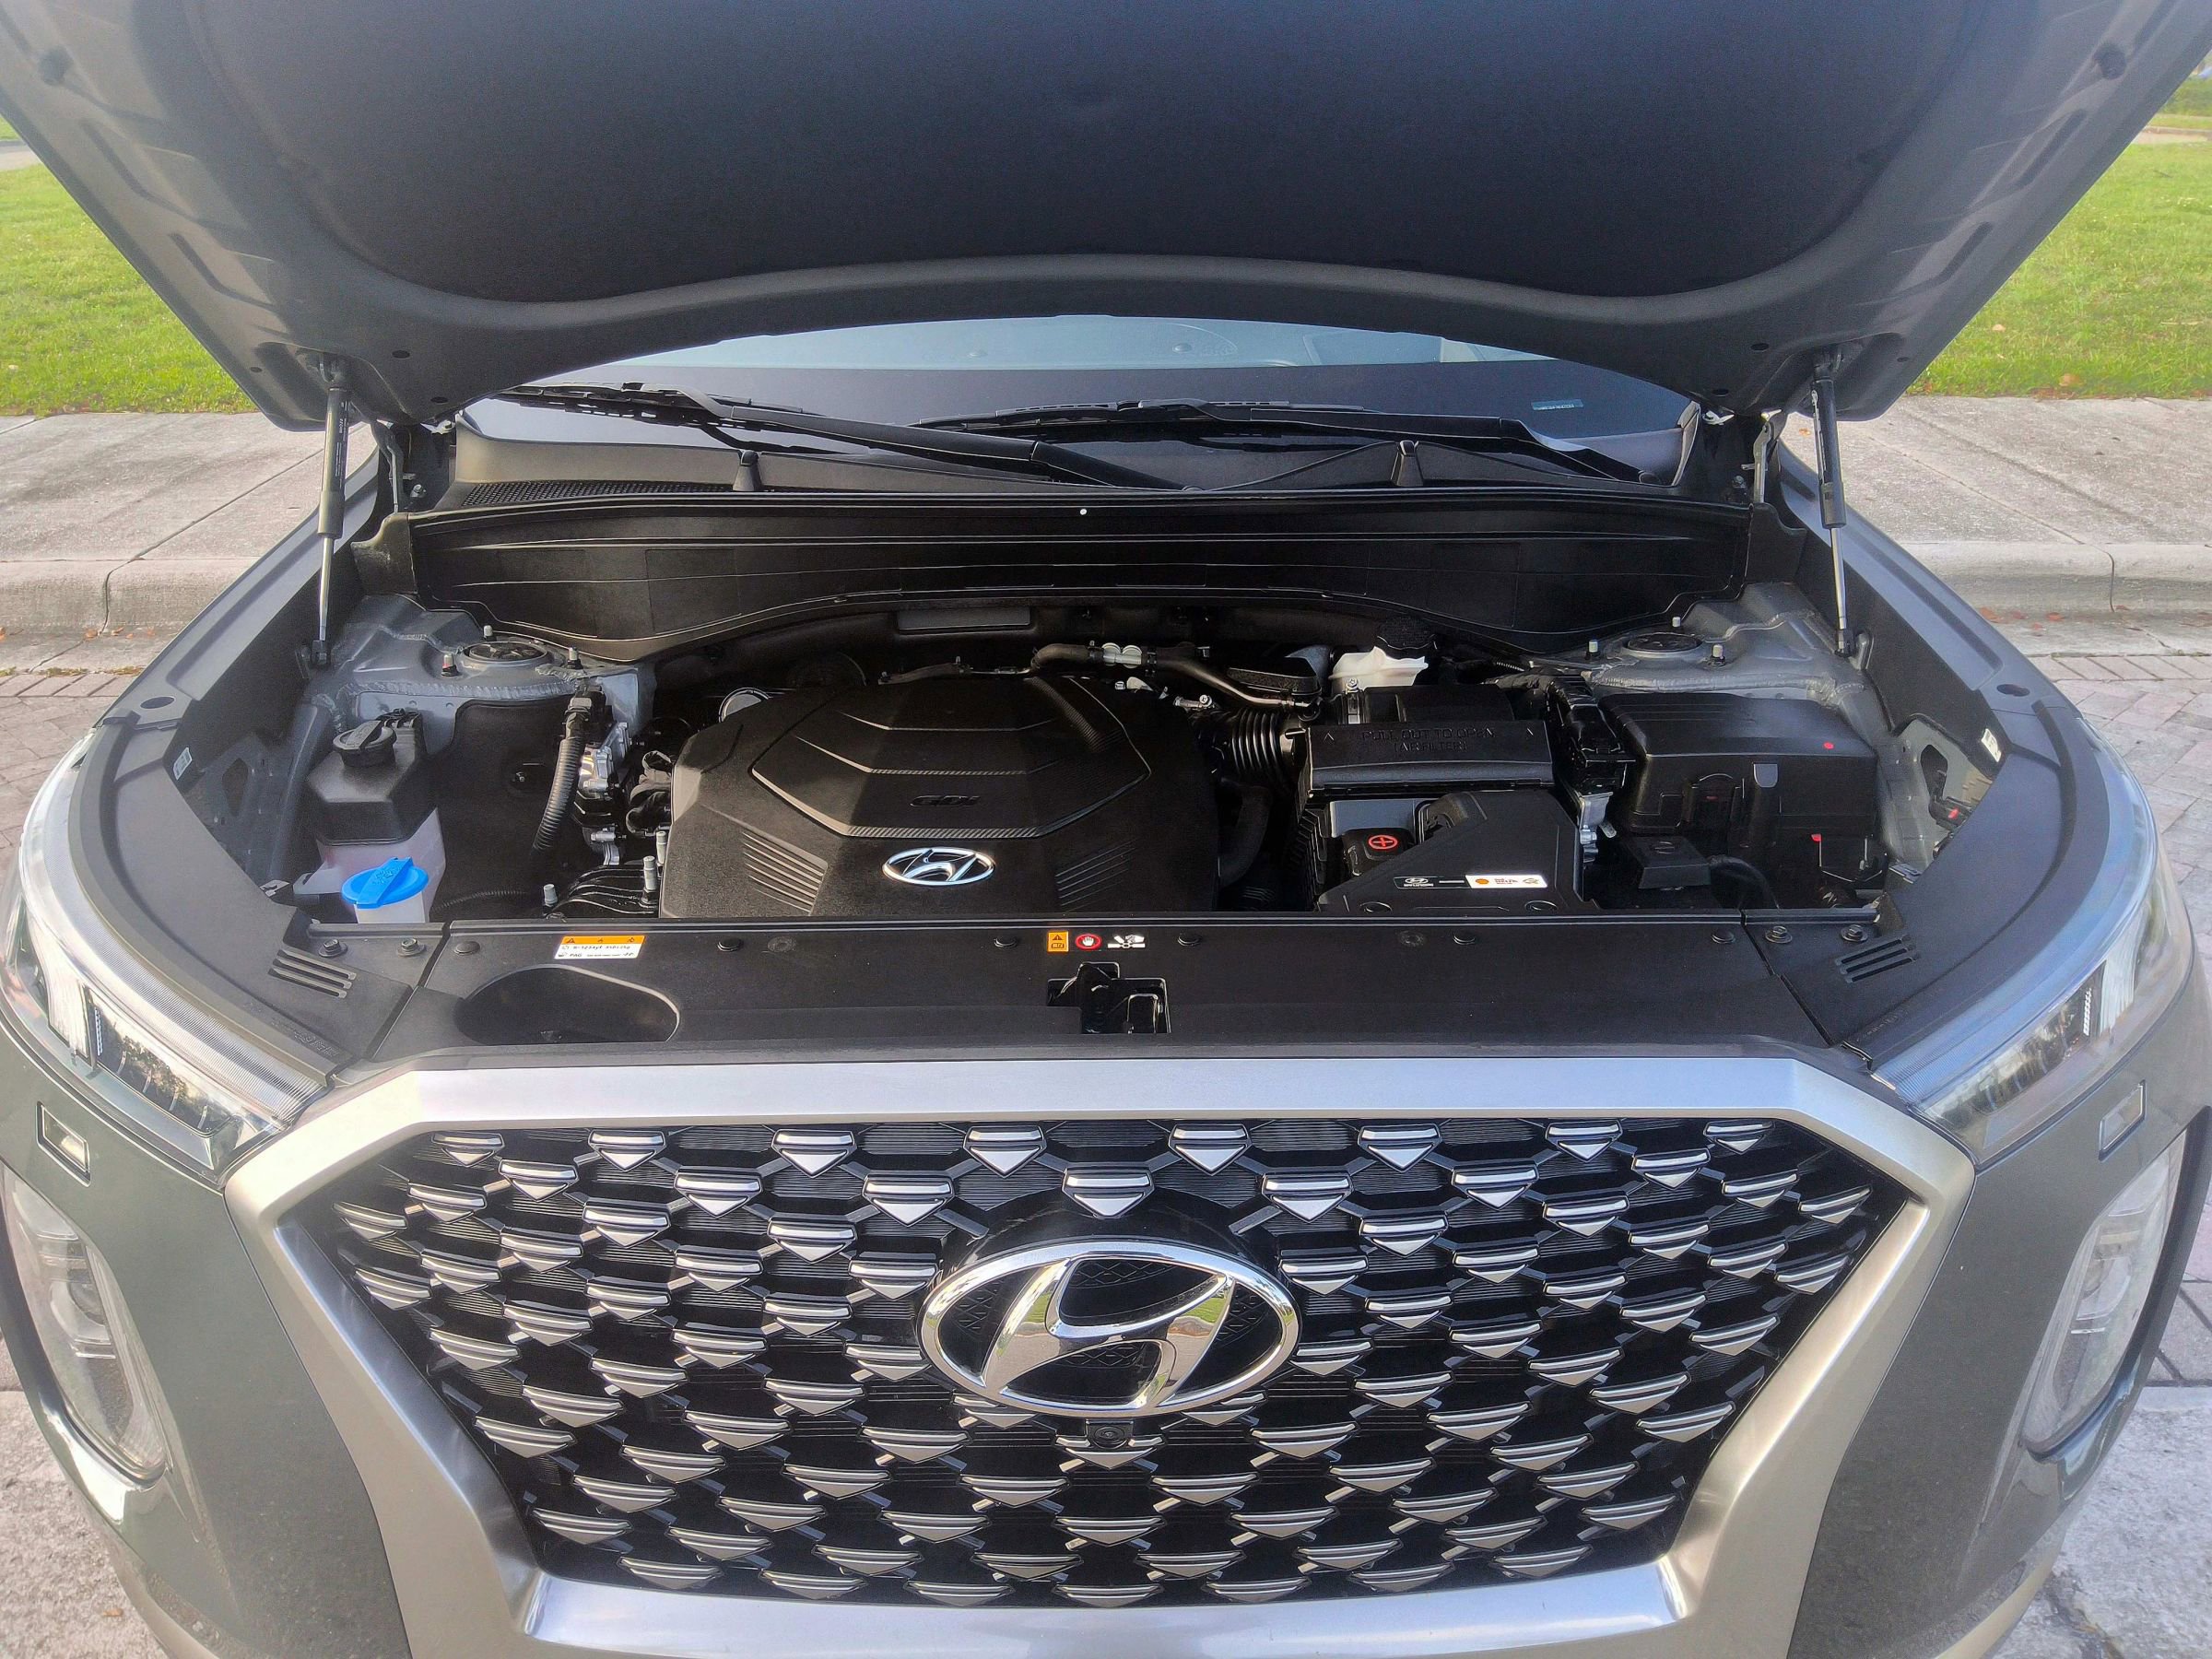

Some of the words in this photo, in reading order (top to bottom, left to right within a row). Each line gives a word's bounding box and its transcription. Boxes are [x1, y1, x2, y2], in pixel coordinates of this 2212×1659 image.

[1362, 730, 1398, 740] PULL
[1402, 729, 1430, 739] OUT
[1433, 728, 1453, 738] TO
[1457, 727, 1495, 738] OPEN
